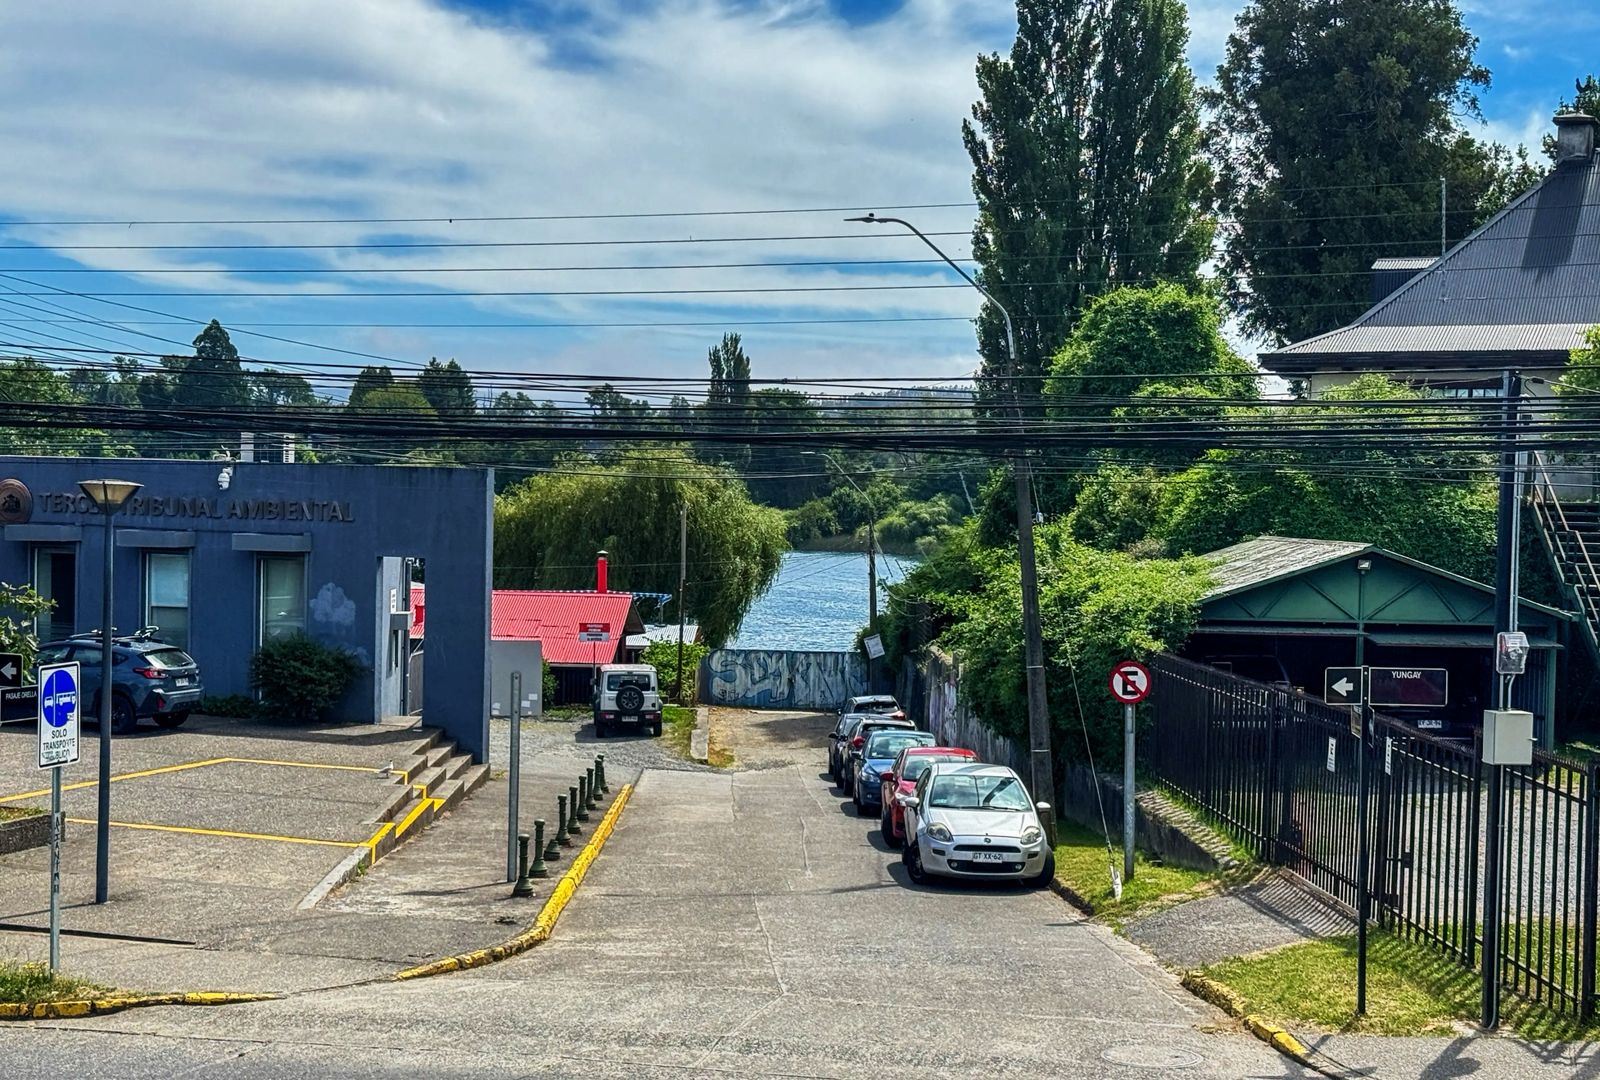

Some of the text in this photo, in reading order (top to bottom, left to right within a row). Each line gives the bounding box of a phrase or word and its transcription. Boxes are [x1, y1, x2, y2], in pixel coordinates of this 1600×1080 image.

[228, 498, 355, 522] AMBIENTAL
[1391, 671, 1422, 679] YUNGAY
[5, 692, 21, 700] PASAJE
[51, 728, 68, 739] SOLO
[43, 738, 75, 750] TRANSPORTE
